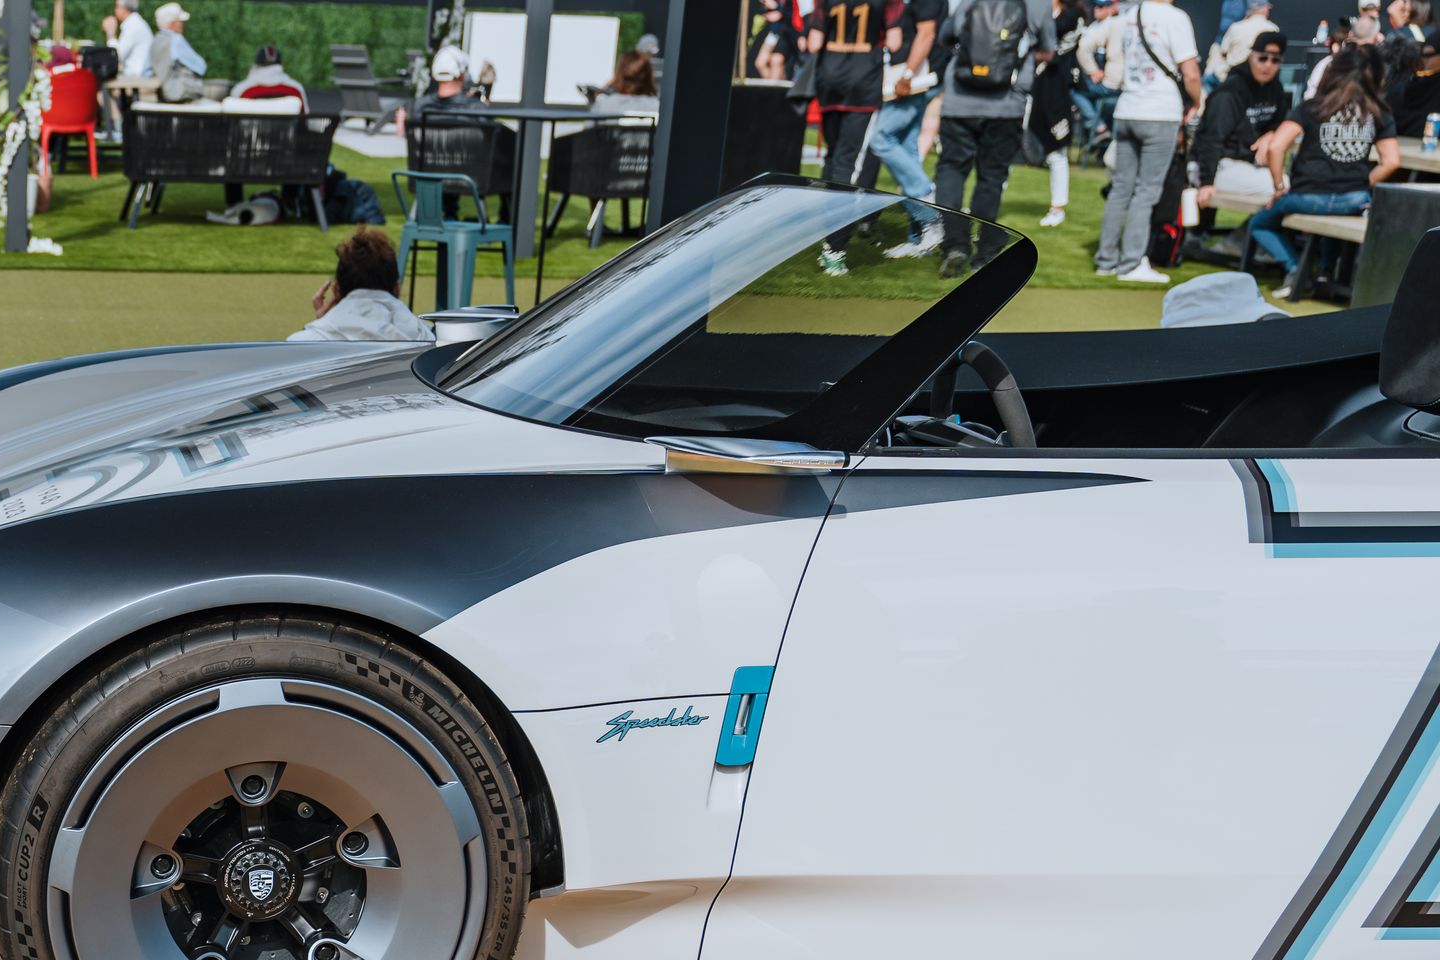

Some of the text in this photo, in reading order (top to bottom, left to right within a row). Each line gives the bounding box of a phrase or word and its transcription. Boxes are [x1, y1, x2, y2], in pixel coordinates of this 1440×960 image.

[826, 3, 872, 52] 11
[596, 705, 709, 743] Speedster
[427, 704, 503, 808] MICHELIN
[32, 805, 44, 820] R
[499, 876, 513, 930] 245/35
[494, 932, 505, 952] ZR
